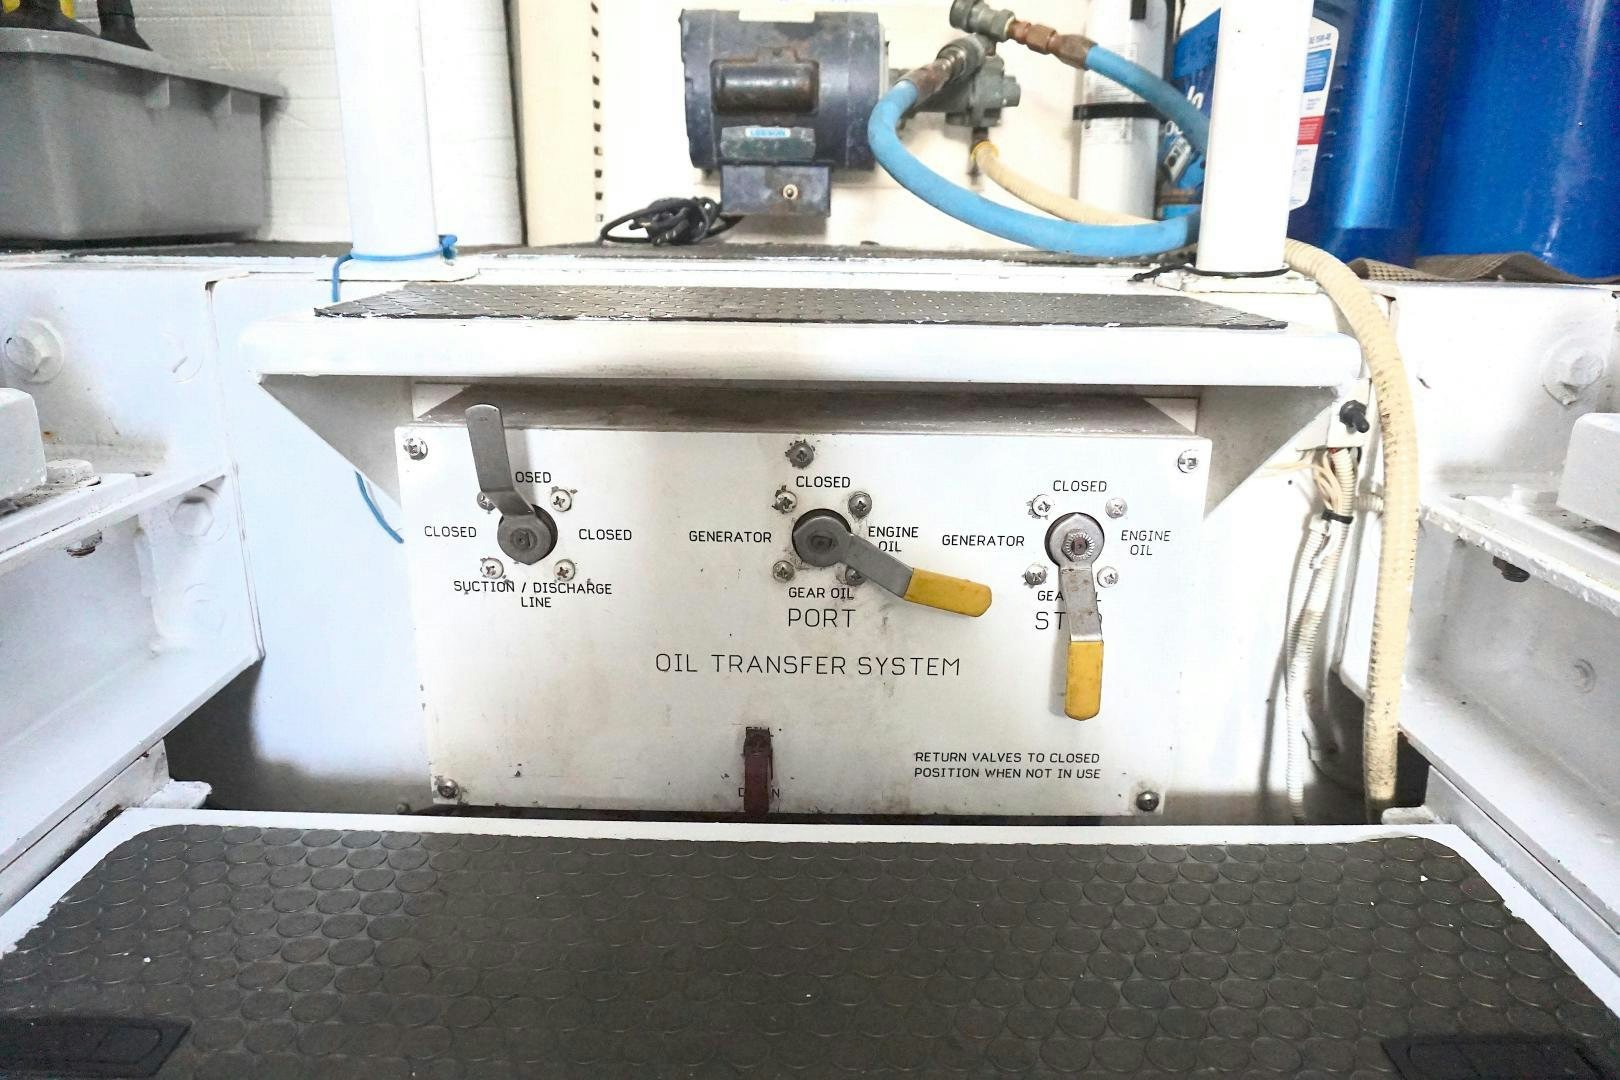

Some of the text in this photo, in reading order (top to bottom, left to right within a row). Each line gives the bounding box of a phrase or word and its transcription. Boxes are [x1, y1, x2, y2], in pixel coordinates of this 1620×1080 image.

[514, 471, 552, 484] OSED
[796, 475, 851, 488] CLOSED
[1052, 480, 1107, 493] CLOSED
[424, 526, 477, 538] CLOSED
[578, 528, 633, 541] CLOSED
[689, 531, 772, 543] GENERATOR
[868, 526, 919, 538] ENGINE
[1121, 530, 1172, 542] ENGINE
[878, 540, 902, 552] OIL
[942, 534, 1025, 547] GENERATOR
[1130, 544, 1153, 556] OIL
[454, 580, 613, 595] SUCTION / DISCHARGE
[788, 587, 855, 600] GEAR OIL
[521, 596, 552, 608] LINE
[1037, 590, 1064, 602] GEA
[788, 608, 857, 628] PORT
[655, 653, 960, 676] OIL TRANSFER SYSTEM
[914, 752, 1100, 764] RETURN VALVES TO CLOSED
[914, 767, 1101, 779] POSITION WHEN NOT IN USE
